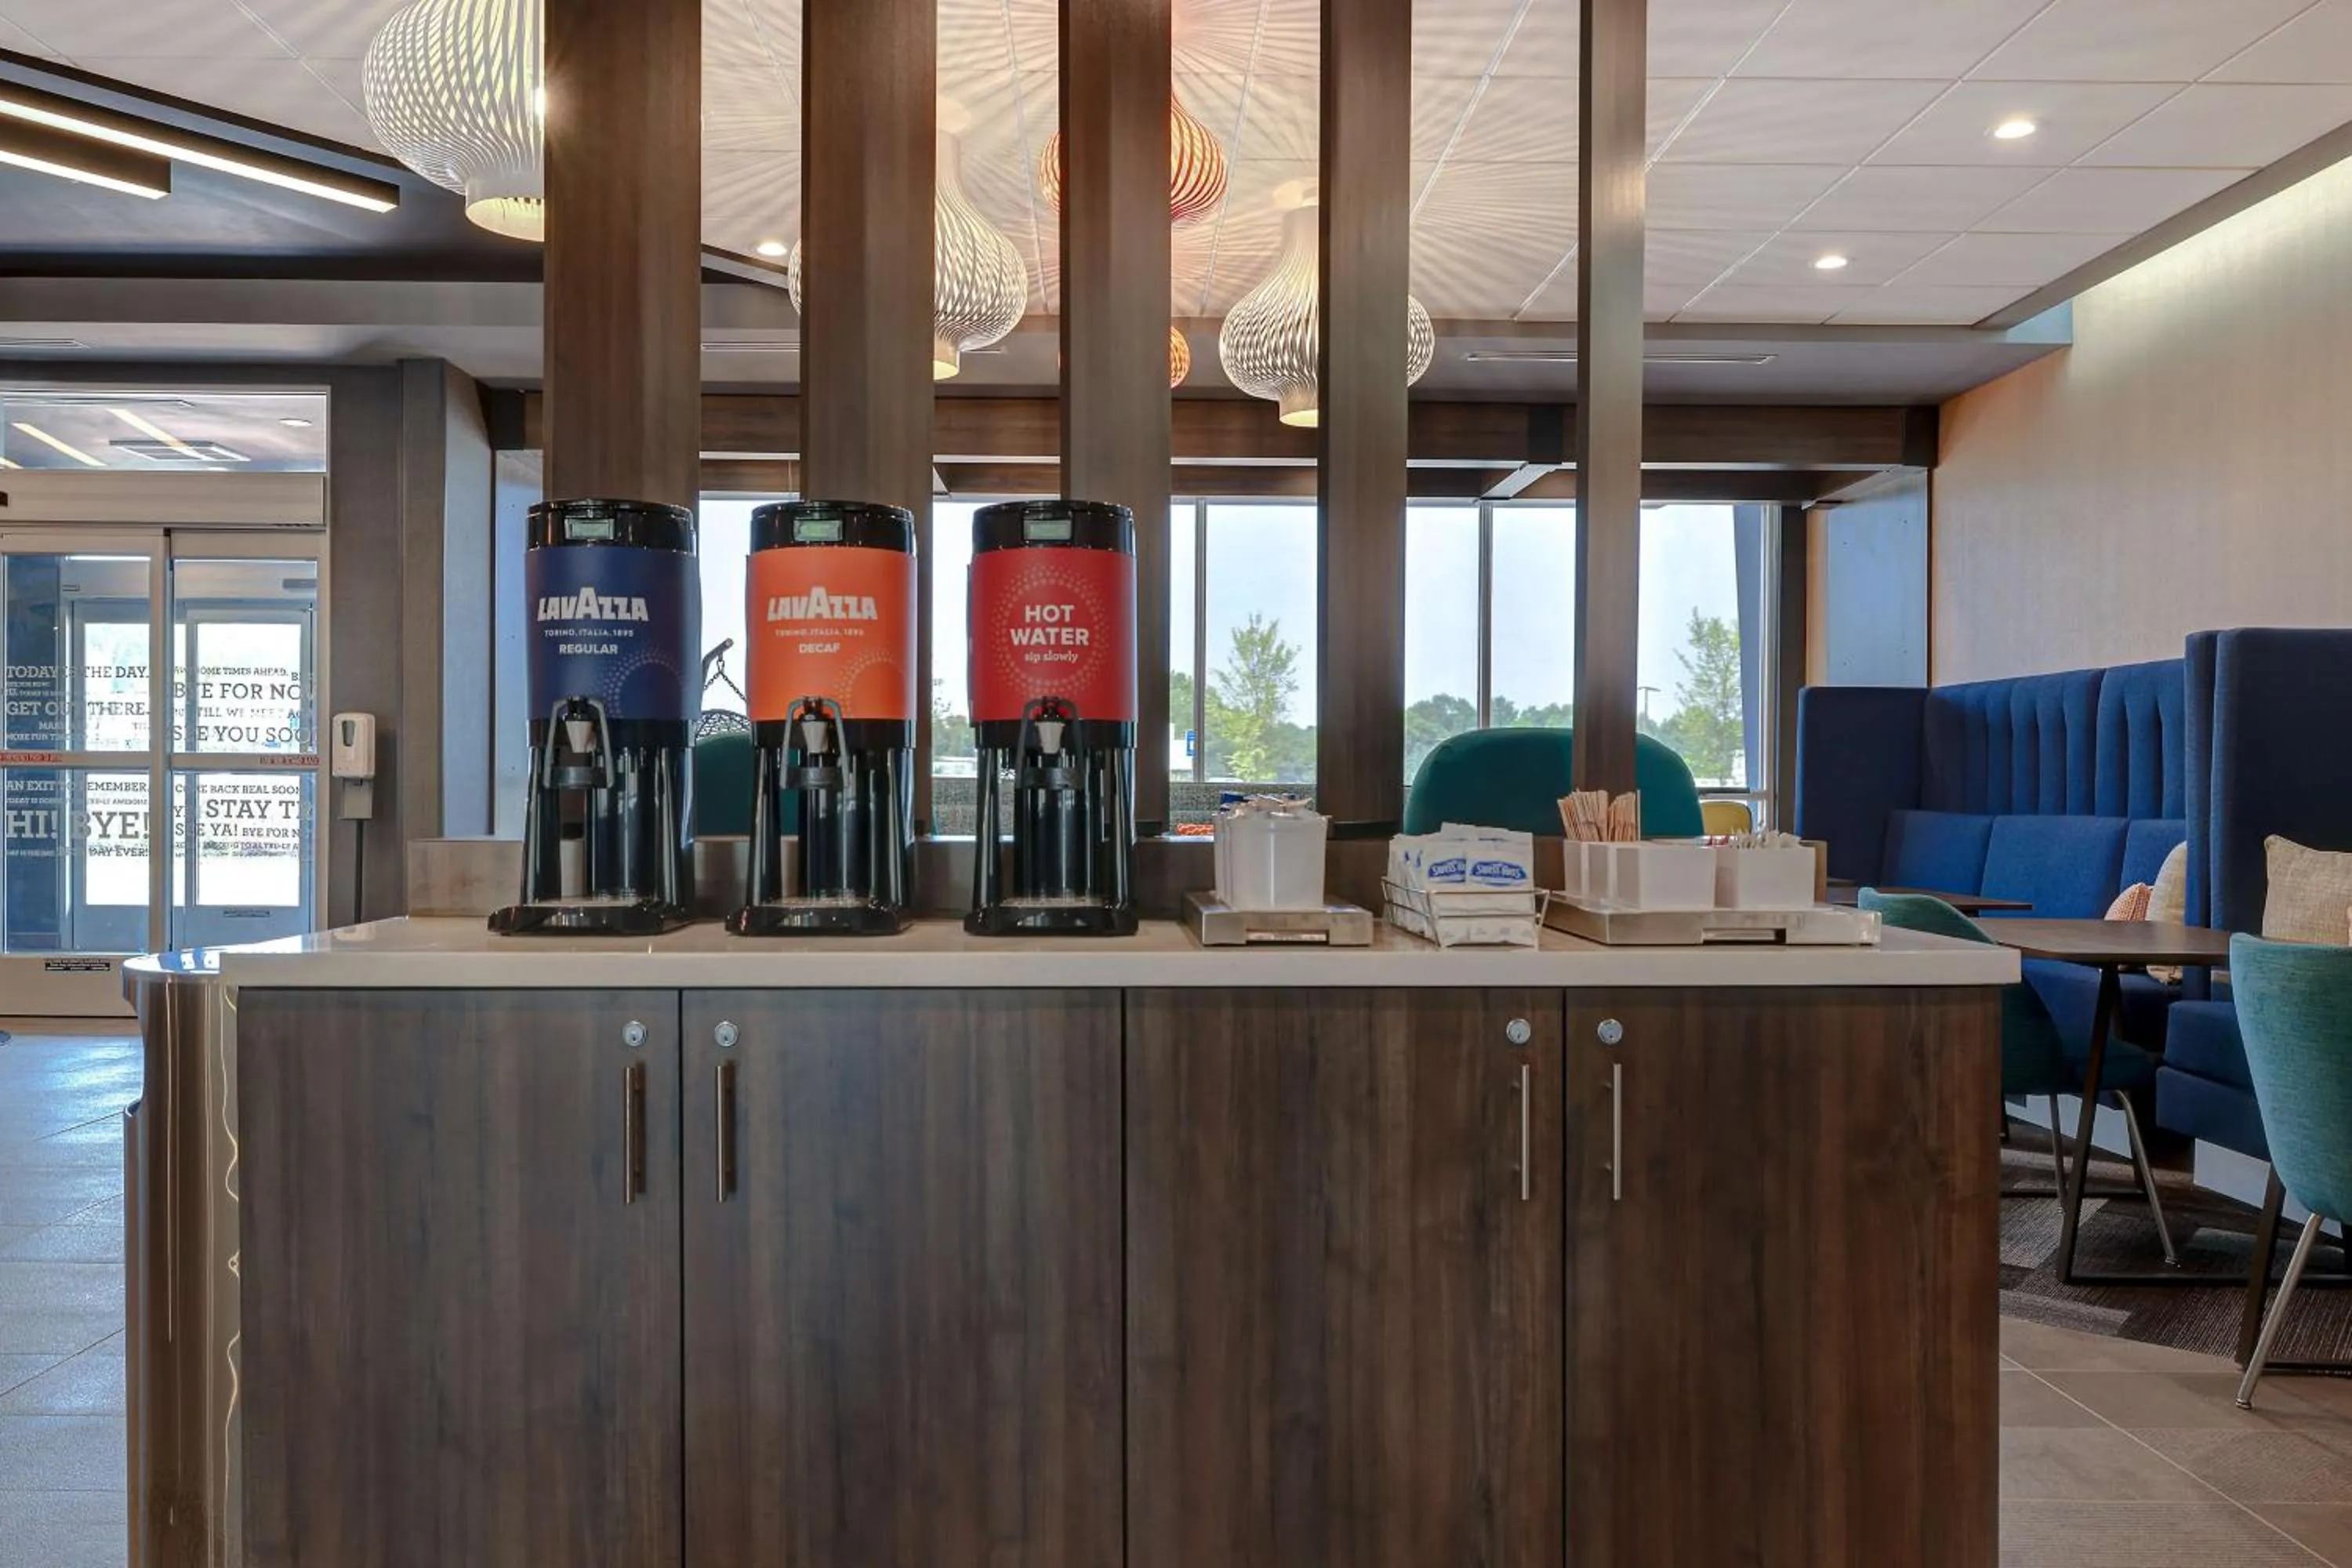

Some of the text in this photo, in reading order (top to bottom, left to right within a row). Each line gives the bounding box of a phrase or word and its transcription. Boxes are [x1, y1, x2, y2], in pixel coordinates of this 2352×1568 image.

[537, 586, 649, 621] LAVAZZA
[768, 586, 878, 621] LAVAZZA
[1025, 604, 1075, 622] HOT
[1010, 627, 1090, 646] WATER
[559, 644, 619, 655] REGULAR
[799, 643, 840, 653] DECAF
[1025, 650, 1078, 663] sip slowly
[7, 666, 57, 678] TODAY
[84, 666, 111, 678] THE
[223, 666, 251, 676] TIMES
[220, 683, 263, 700] FOR
[7, 702, 41, 715] GET
[173, 725, 311, 744] SE YOU SOO
[7, 780, 25, 791] AN
[27, 780, 54, 791] EXIT
[210, 785, 240, 794] BACK
[242, 785, 269, 794] REAL
[206, 799, 272, 819] STAY
[7, 810, 57, 839] HI!
[71, 811, 150, 840] BYE!
[175, 823, 205, 837] SE
[210, 823, 238, 837] YA!
[242, 828, 264, 837] BYE
[266, 828, 290, 838] FOR
